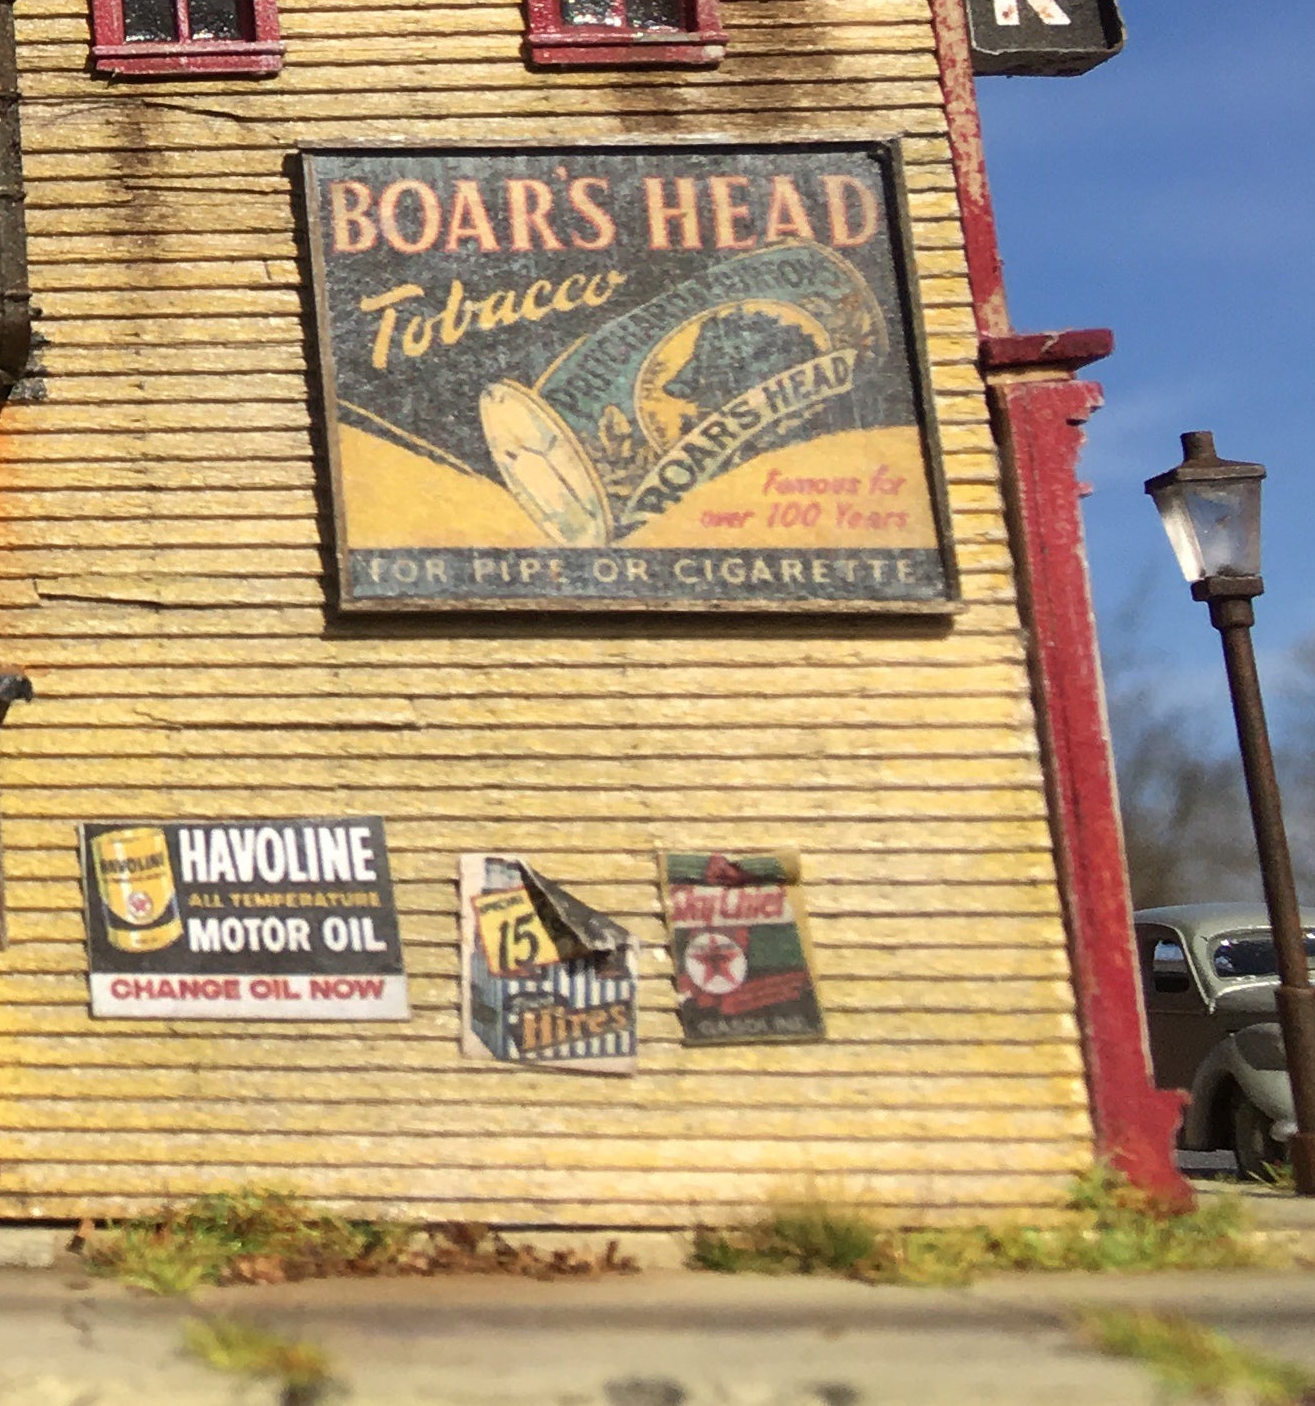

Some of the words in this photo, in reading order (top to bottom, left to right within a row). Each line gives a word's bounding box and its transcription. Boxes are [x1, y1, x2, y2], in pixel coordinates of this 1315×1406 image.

[328, 165, 617, 253] BOAR'S
[643, 173, 878, 250] HEAD
[360, 270, 627, 370] Tobacco
[762, 354, 851, 414] HEAD
[762, 468, 860, 494] Famous
[868, 464, 907, 495] for
[700, 510, 755, 528] over
[767, 501, 822, 528] 100
[834, 501, 909, 529] Years
[592, 557, 649, 583] OR
[673, 557, 918, 585] CIGARETTE
[178, 825, 377, 884] HAVOLINE
[187, 892, 224, 908] ALL
[231, 890, 382, 908] TEMPERATURE
[187, 915, 312, 952] MOTOR
[323, 915, 388, 952] OIL
[499, 912, 540, 971] 15
[109, 977, 241, 1001] CHANGE
[249, 978, 301, 1000] OIL
[309, 978, 385, 1001] NOW
[522, 1004, 628, 1050] Hires
